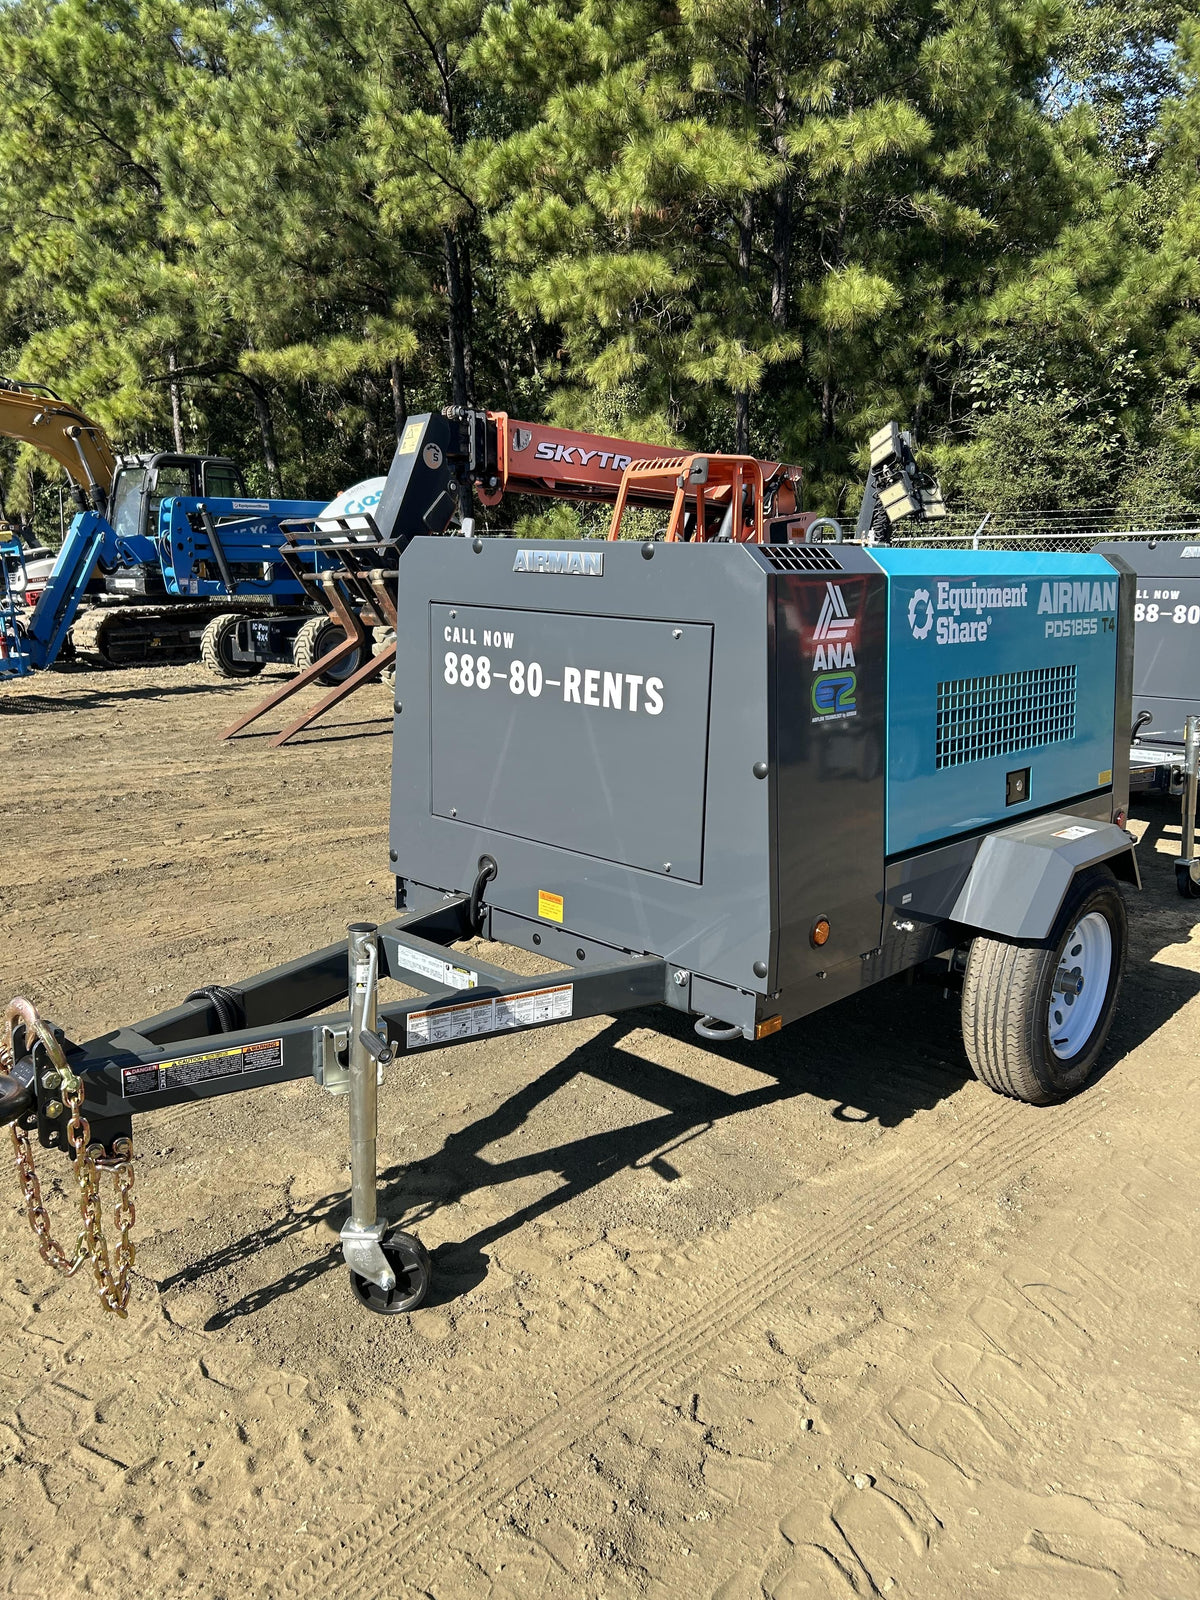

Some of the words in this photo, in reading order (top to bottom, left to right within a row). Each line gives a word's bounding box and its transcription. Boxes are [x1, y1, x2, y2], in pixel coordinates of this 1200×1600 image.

[513, 550, 604, 576] AIRMAN
[937, 581, 1028, 615] Equipment
[1037, 581, 1117, 615] AIRMAN
[1153, 590, 1180, 600] NOW
[444, 626, 477, 645] CALL
[483, 629, 515, 649] NOW
[1045, 618, 1098, 639] PDS185S
[1102, 616, 1115, 633] T4
[812, 642, 856, 671] ANA
[444, 651, 664, 715] 888-80-RENTS
